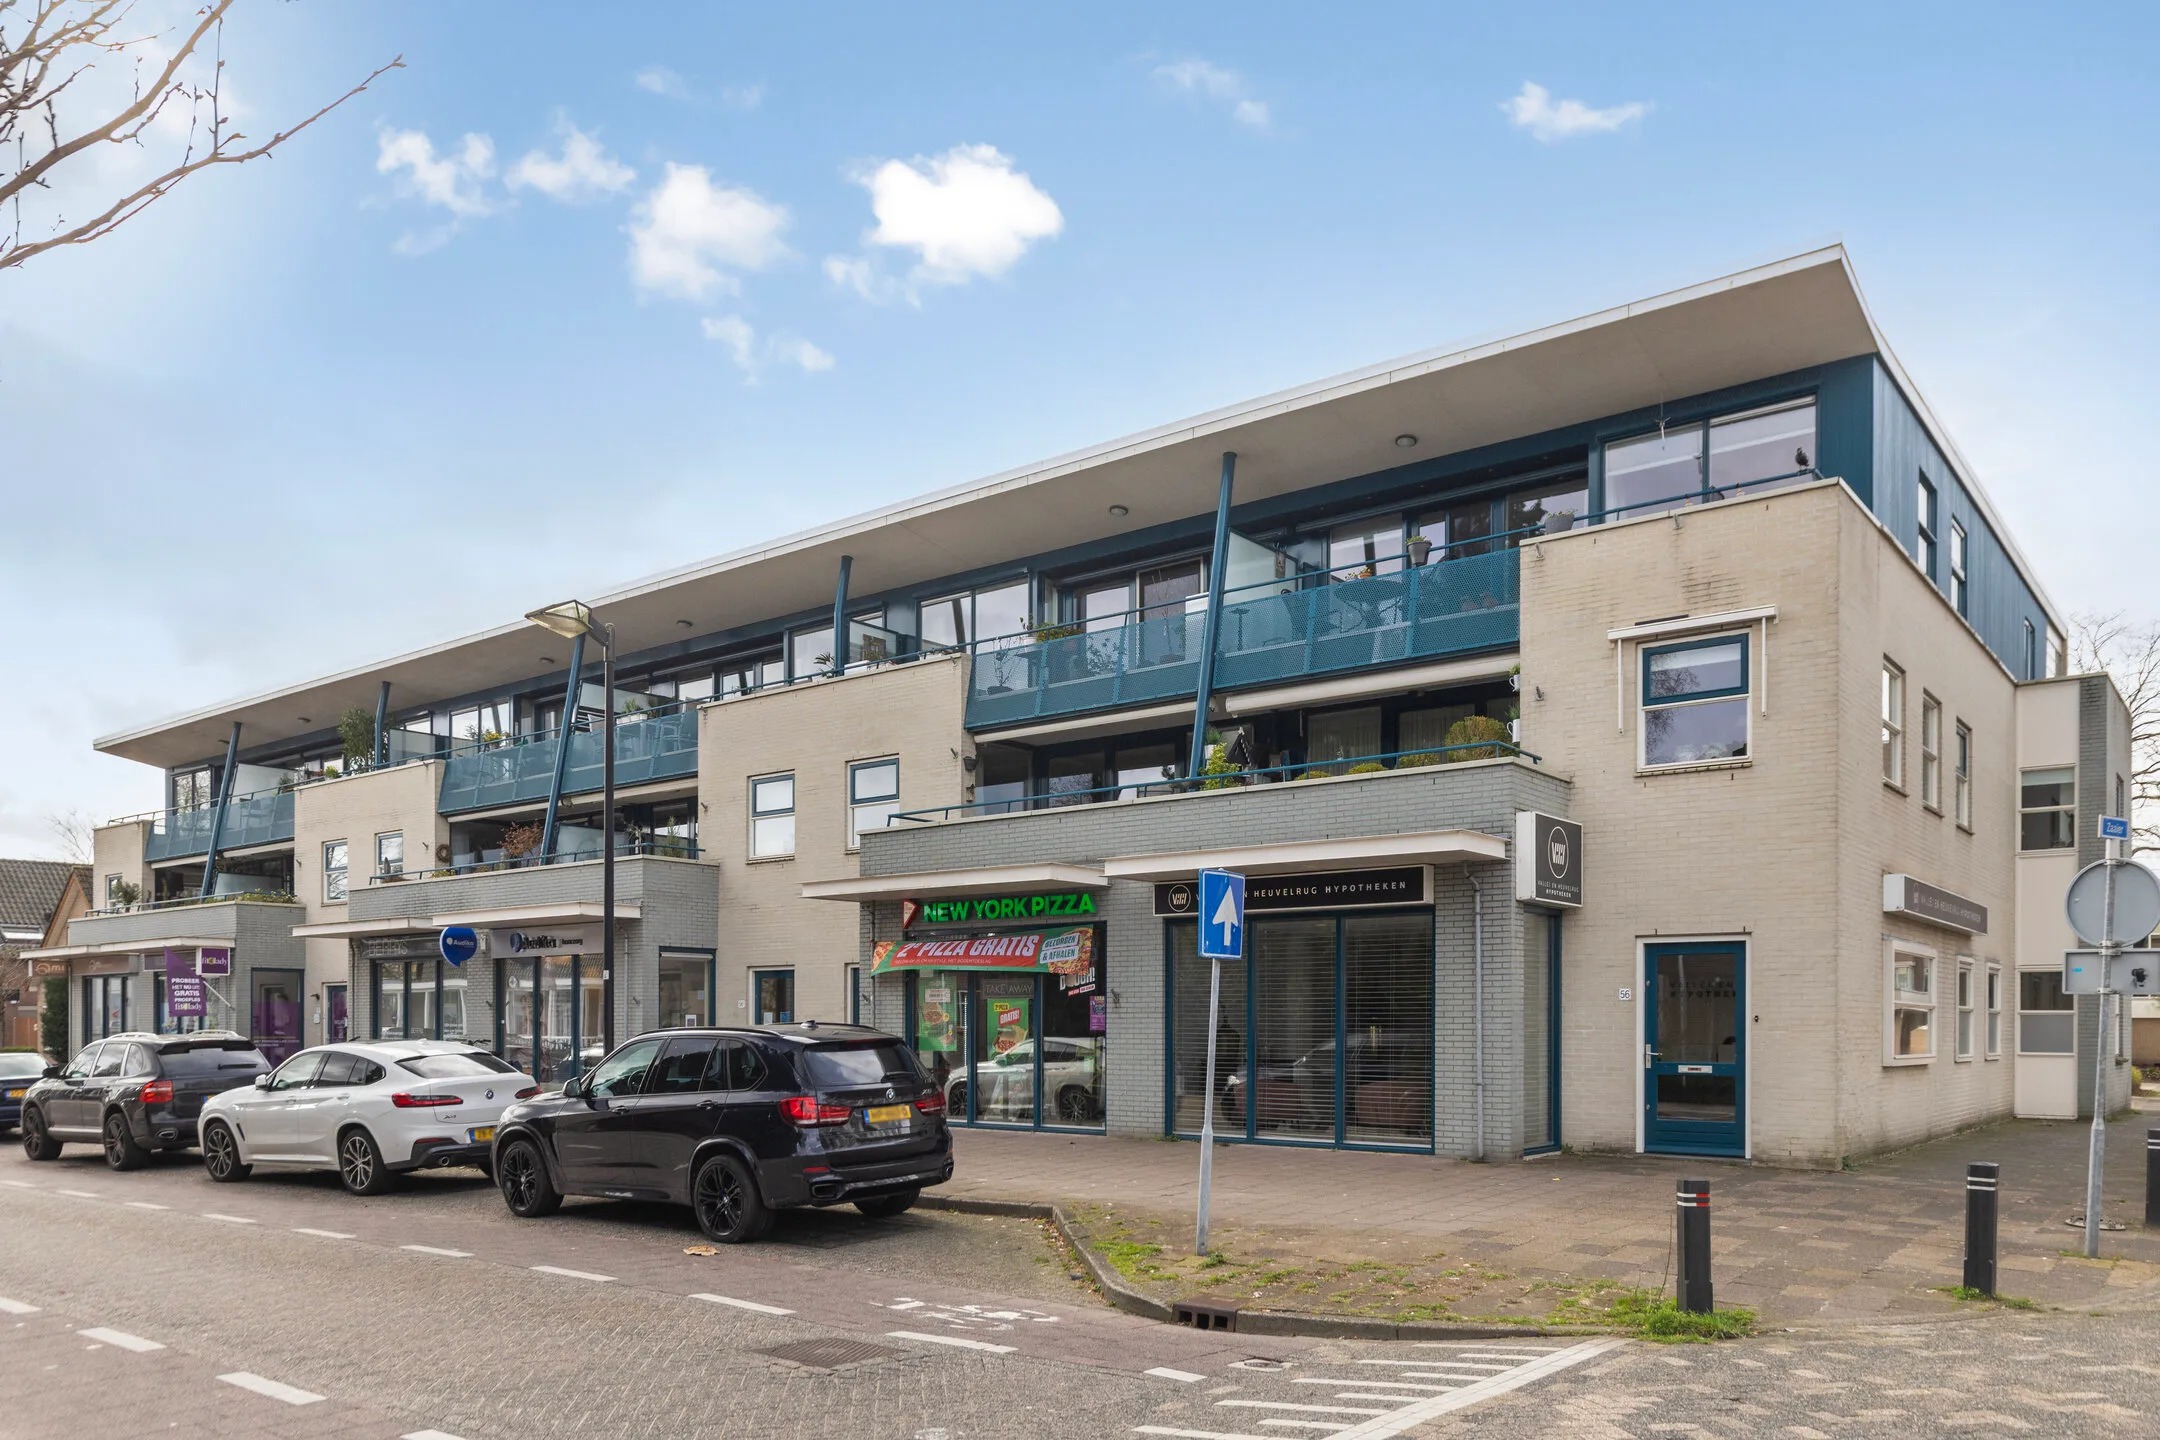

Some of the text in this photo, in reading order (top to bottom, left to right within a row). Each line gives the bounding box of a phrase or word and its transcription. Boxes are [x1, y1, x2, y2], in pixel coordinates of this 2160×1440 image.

[1253, 886, 1318, 898] HEUVELRUG
[1325, 880, 1407, 894] HYPOTHEKEN
[923, 900, 970, 922] NEW
[973, 896, 1029, 920] YORK
[1031, 893, 1096, 917] PIZZA
[916, 938, 964, 956] PIZZA
[969, 935, 1040, 957] GRATIS
[1044, 936, 1077, 948] BEZORGEN
[1048, 948, 1076, 960] AFHALEN
[985, 984, 1033, 993] TAKE AWAY
[1619, 989, 1630, 999] 56
